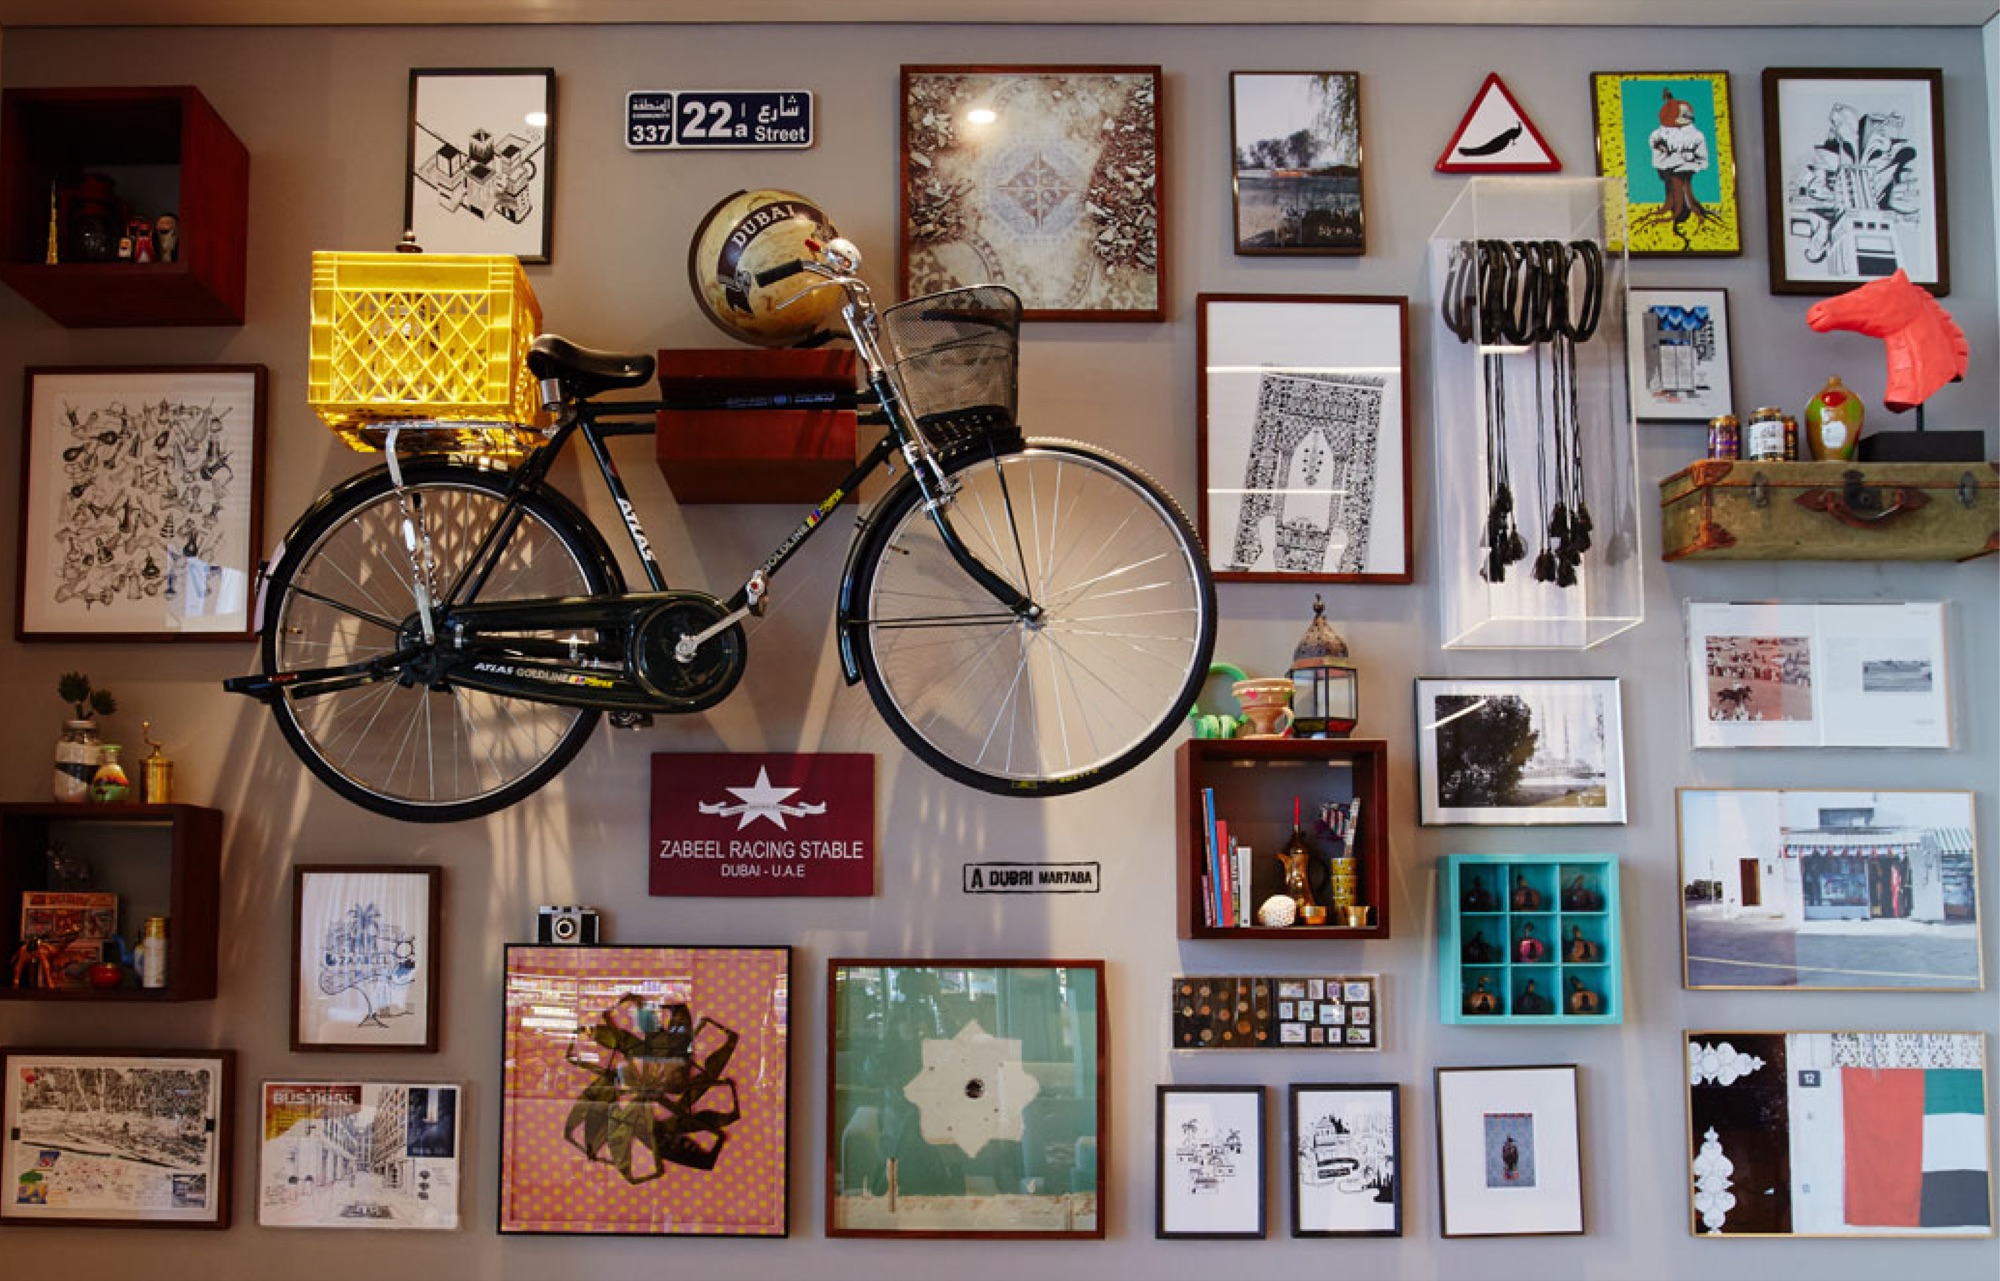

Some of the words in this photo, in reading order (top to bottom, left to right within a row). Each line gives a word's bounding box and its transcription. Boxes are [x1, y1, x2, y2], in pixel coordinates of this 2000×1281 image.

[758, 95, 799, 123] شارع
[632, 125, 670, 142] 337
[755, 125, 805, 142] Street
[732, 204, 795, 248] DUBAI
[660, 840, 725, 859] ZABEEL
[729, 840, 795, 859] RACING
[799, 841, 864, 859] STABLE
[721, 864, 761, 878] DUBAI
[971, 867, 984, 888] A
